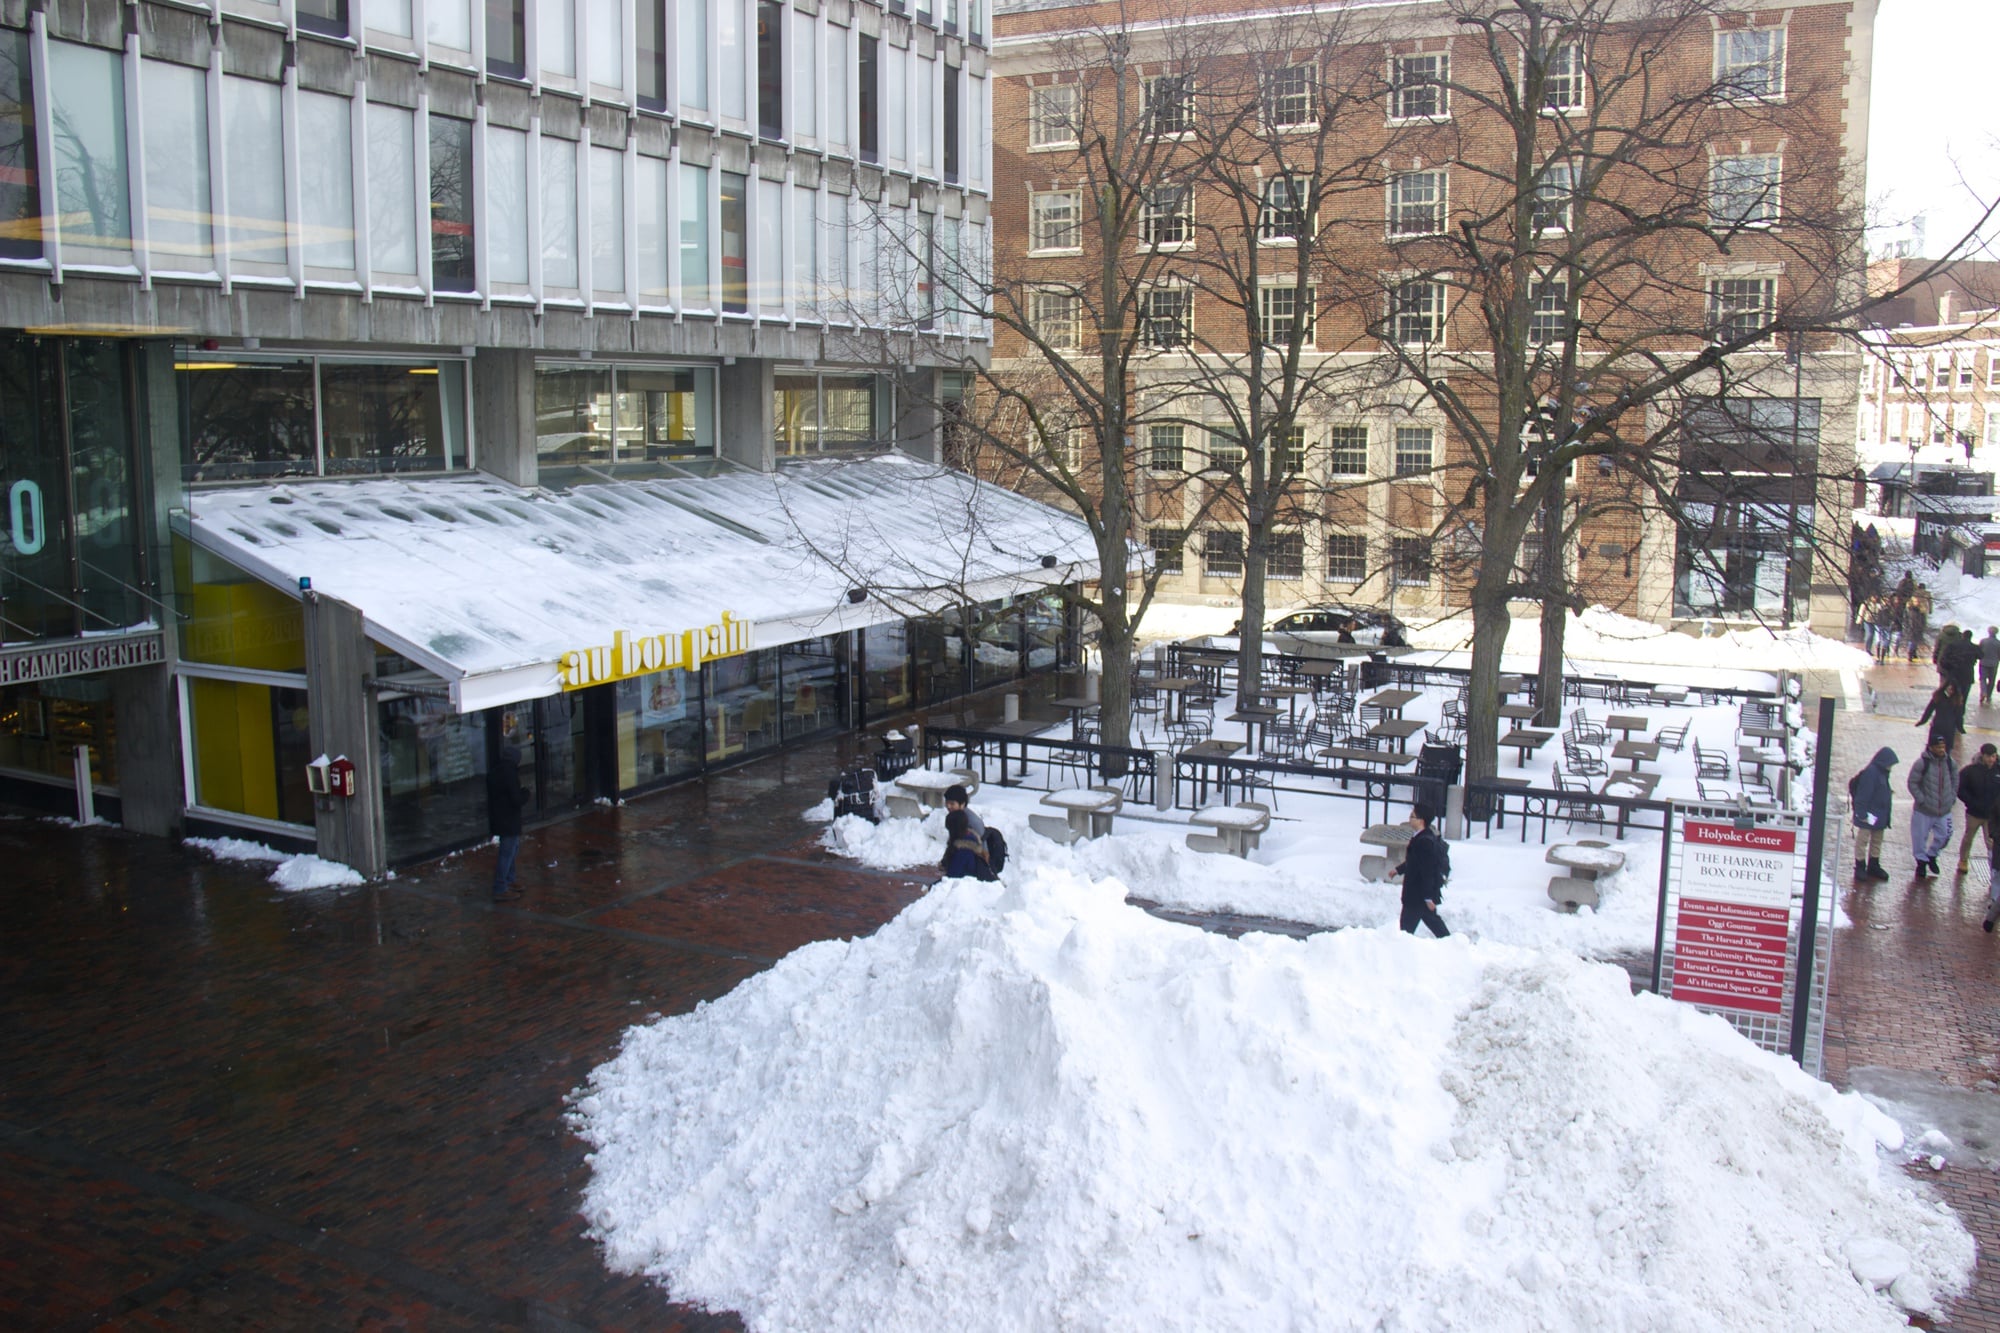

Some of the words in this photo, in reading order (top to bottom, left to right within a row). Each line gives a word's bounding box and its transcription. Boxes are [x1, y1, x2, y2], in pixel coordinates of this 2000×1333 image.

[562, 646, 613, 688] au
[614, 630, 683, 675] bon
[685, 610, 754, 672] pain
[17, 649, 91, 681] CAMPUS
[96, 640, 159, 669] CENTER
[1698, 828, 1742, 842] Holyoke
[1745, 832, 1782, 845] Center
[1695, 852, 1719, 863] THE
[1724, 855, 1783, 869] HARVARD
[1700, 866, 1725, 878] BOX
[1729, 869, 1774, 882] OFFICE
[1683, 901, 1705, 910] Events
[1706, 904, 1719, 912] and
[1720, 905, 1760, 916] Information
[1761, 910, 1785, 919] Center
[1708, 919, 1725, 929] Oggi
[1726, 921, 1756, 931] Gourmet
[1701, 933, 1715, 942] The
[1716, 935, 1743, 945] Harvard
[1744, 939, 1762, 949] Shop
[1682, 946, 1709, 956] Harvard
[1710, 948, 1743, 961] University
[1745, 953, 1777, 966] Pharmacy
[1683, 962, 1710, 972] Harvard
[1711, 965, 1733, 975] Center
[1735, 967, 1745, 977] for
[1746, 969, 1775, 980] Wellness
[1687, 977, 1699, 985] Al's
[1700, 979, 1728, 989] Harvard
[1729, 983, 1751, 993] Square
[1753, 986, 1768, 995] Café
